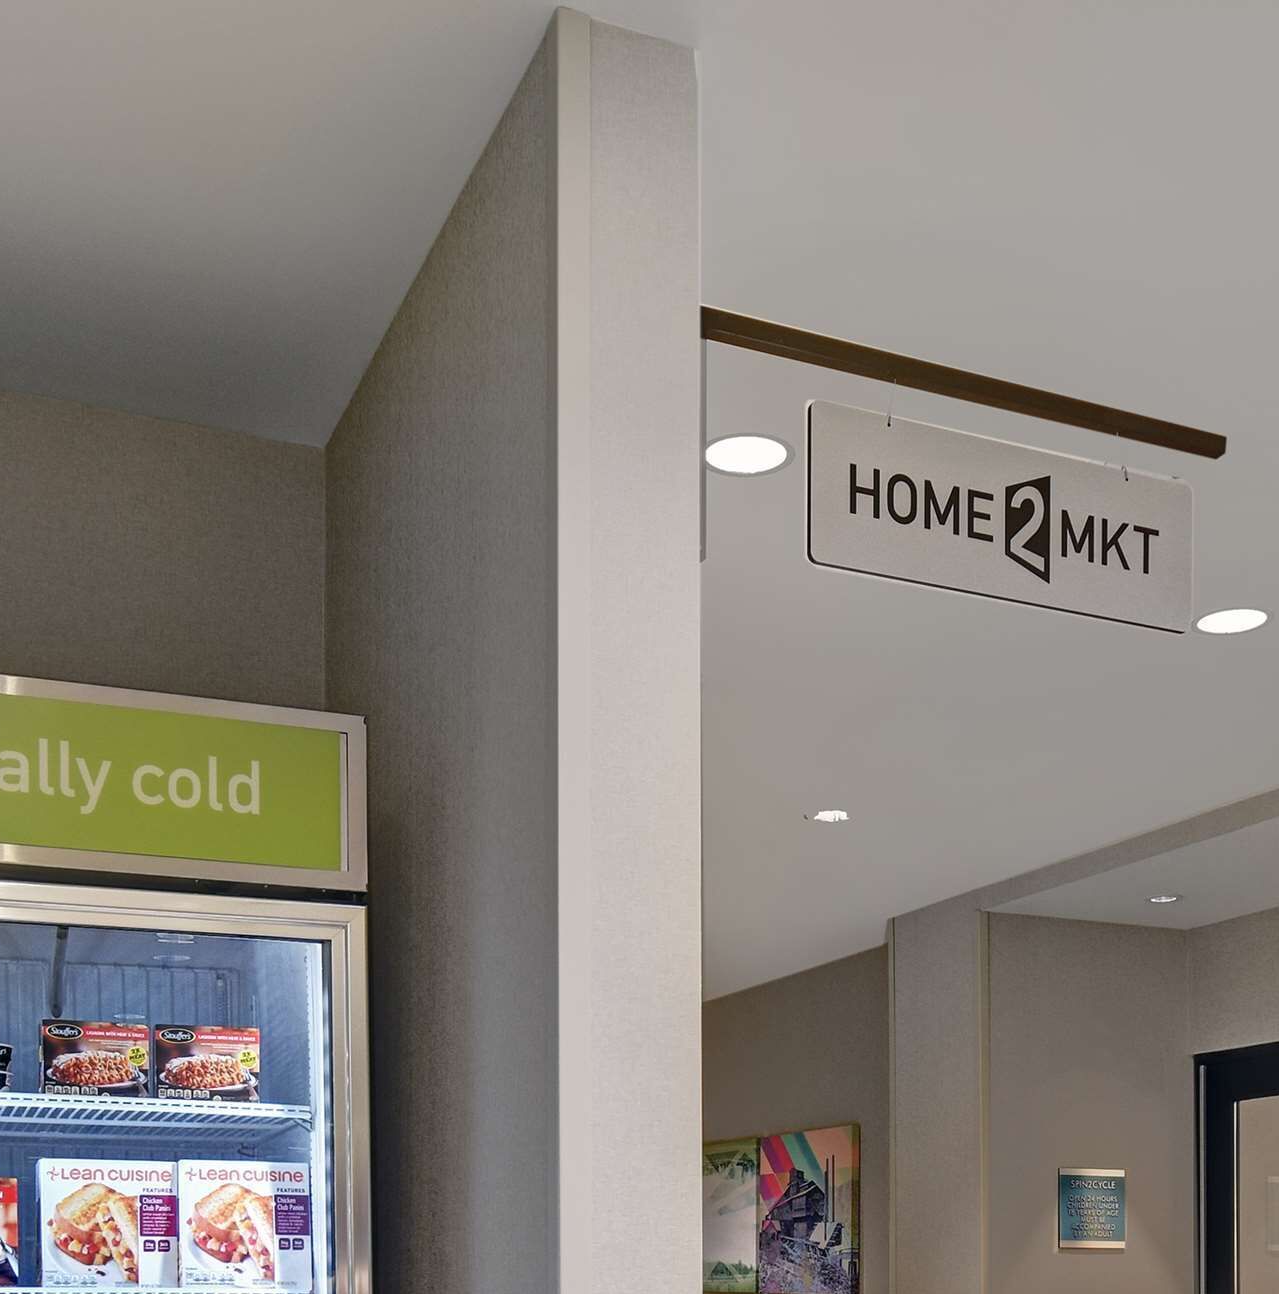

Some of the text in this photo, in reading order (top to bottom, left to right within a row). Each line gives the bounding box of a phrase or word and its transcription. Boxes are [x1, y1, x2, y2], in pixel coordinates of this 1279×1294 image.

[849, 462, 1159, 584] HOME2MKT
[131, 754, 261, 815] cold
[1070, 1180, 1116, 1189] SPIN2CYCLE
